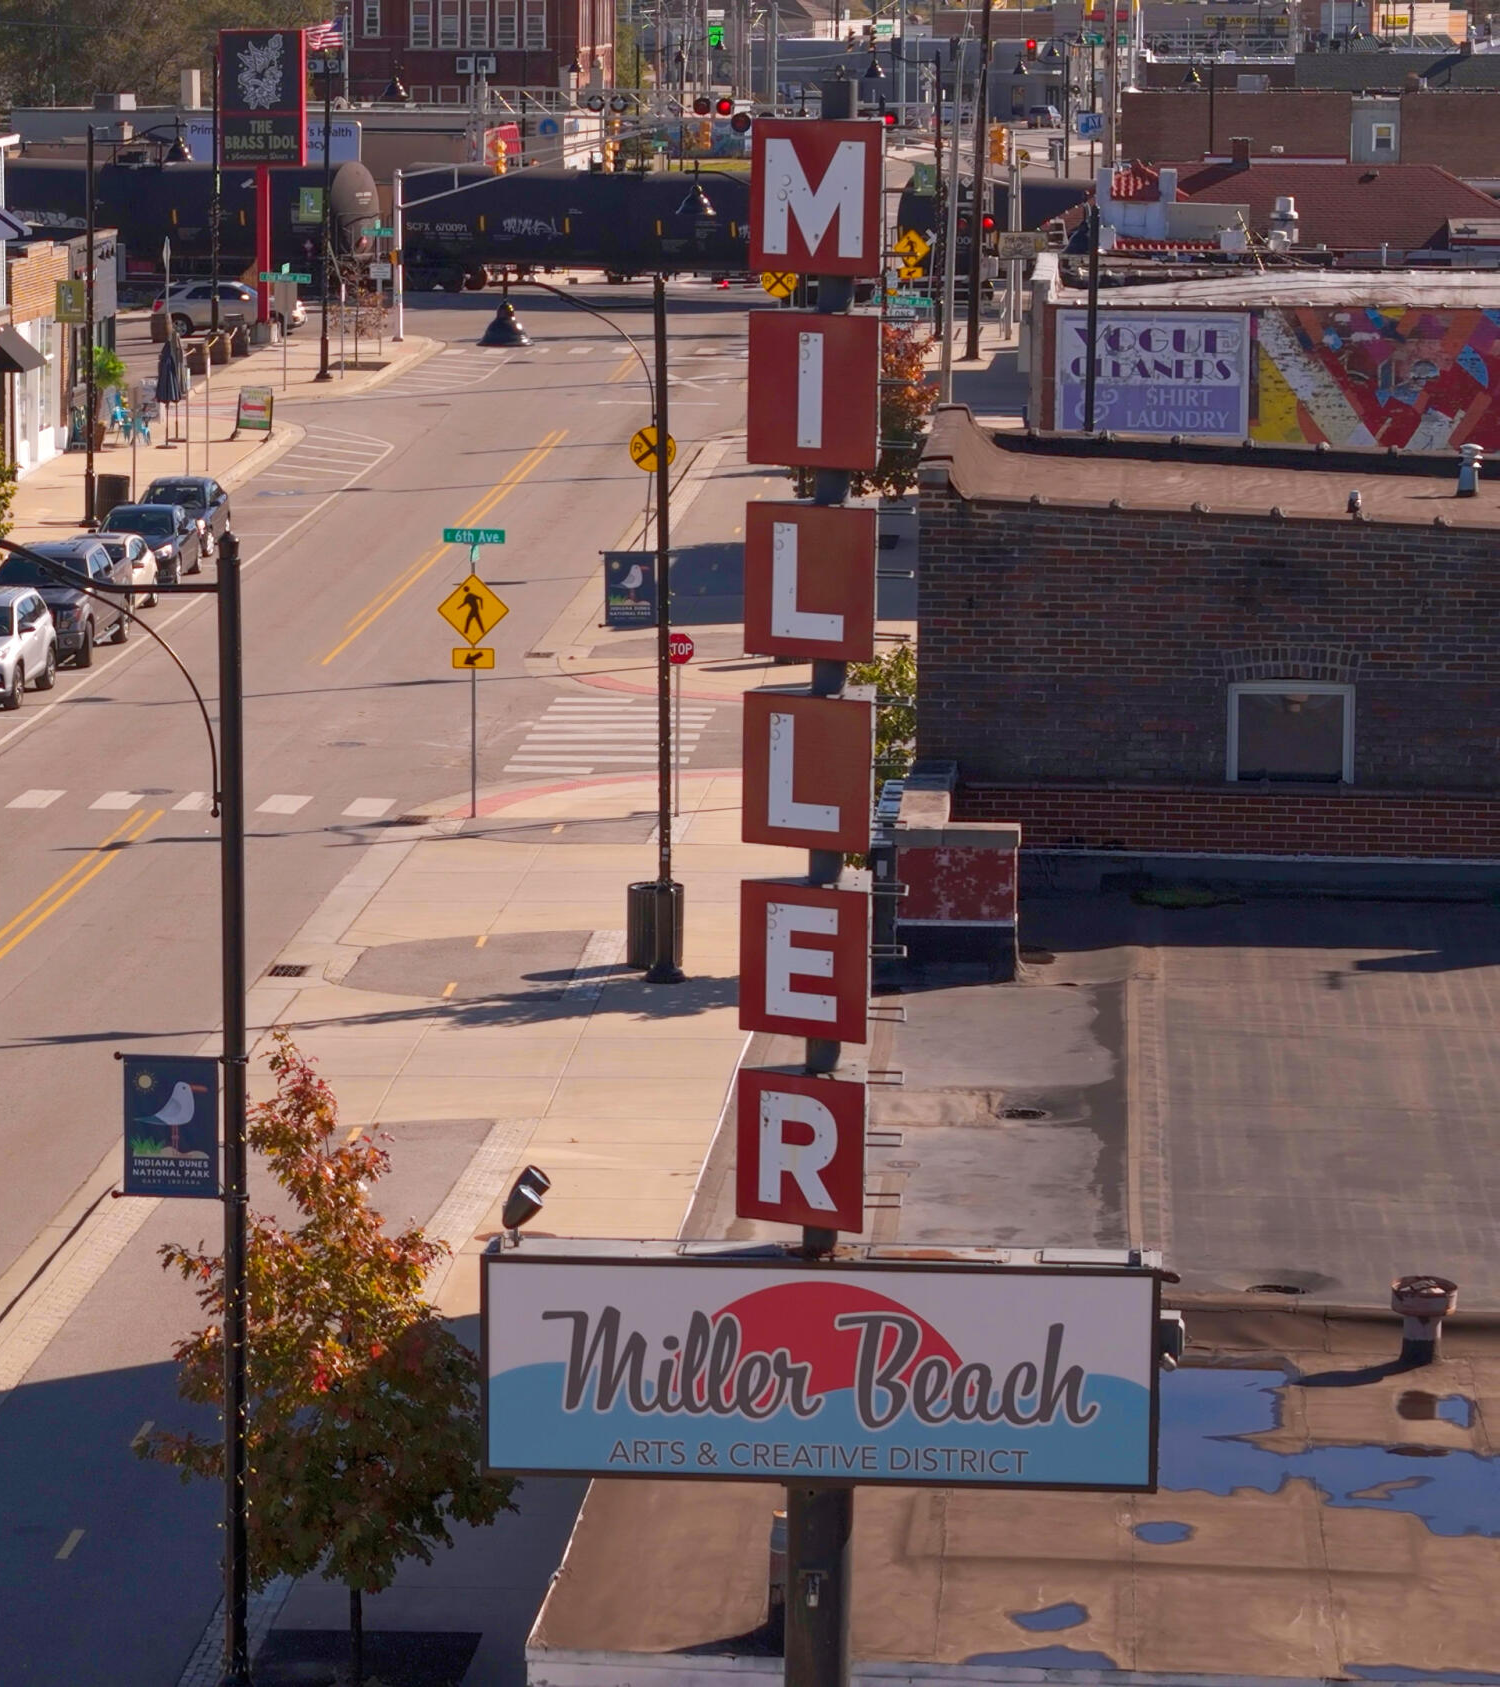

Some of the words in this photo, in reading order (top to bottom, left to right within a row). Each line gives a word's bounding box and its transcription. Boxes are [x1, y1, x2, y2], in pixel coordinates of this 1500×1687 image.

[249, 120, 273, 134] THE
[317, 127, 352, 137] Halth
[224, 135, 265, 149] BRASS
[269, 135, 297, 149] IDOL
[406, 222, 430, 231] SCFX
[1074, 325, 1241, 354] VOGUE
[1071, 357, 1232, 380] CLEANERS
[1146, 387, 1213, 407] SHIRT
[1127, 410, 1229, 429] LAUNDRY
[455, 531, 474, 542] 6th
[134, 1159, 175, 1167] INDIANA
[179, 1160, 209, 1168] DUNES
[132, 1168, 181, 1177] NATIONAL
[184, 1170, 210, 1178] PARK
[541, 1306, 824, 1418] Miller
[833, 1312, 1099, 1429] Beach
[609, 1440, 685, 1467] ARTS
[696, 1442, 720, 1467] &
[729, 1442, 878, 1472] CREATIVE
[889, 1447, 1030, 1475] DISTRICT
